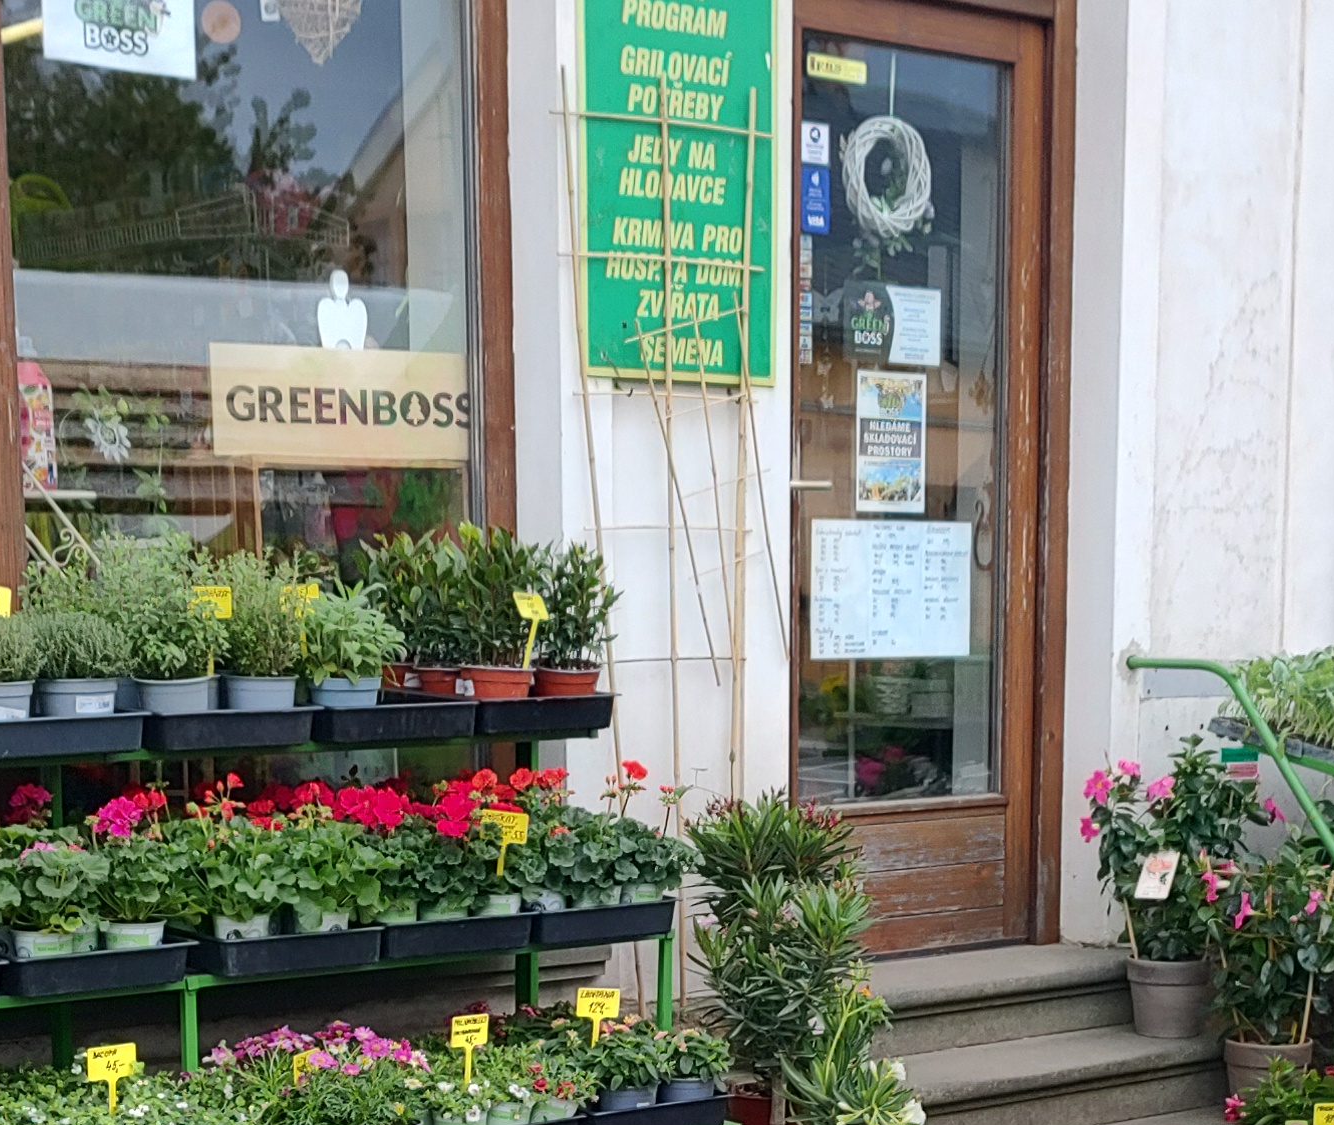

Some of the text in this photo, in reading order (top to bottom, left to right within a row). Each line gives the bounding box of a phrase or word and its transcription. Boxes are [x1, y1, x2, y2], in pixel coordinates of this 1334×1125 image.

[621, 0, 728, 39] PROGRAM
[85, 23, 147, 54] BOSS
[620, 44, 733, 87] GRILOVACÍ
[627, 81, 725, 122] POŘEBY
[688, 140, 715, 171] NA
[701, 224, 743, 254] PRO
[673, 256, 688, 284] A
[637, 283, 720, 321] ZVŘATA
[640, 335, 723, 368] SEMENA
[225, 384, 468, 430] GREENBOSS
[863, 431, 917, 446] SKLADOVACÍ
[869, 419, 911, 433] HLEDÁME
[867, 445, 912, 458] PROSTORY
